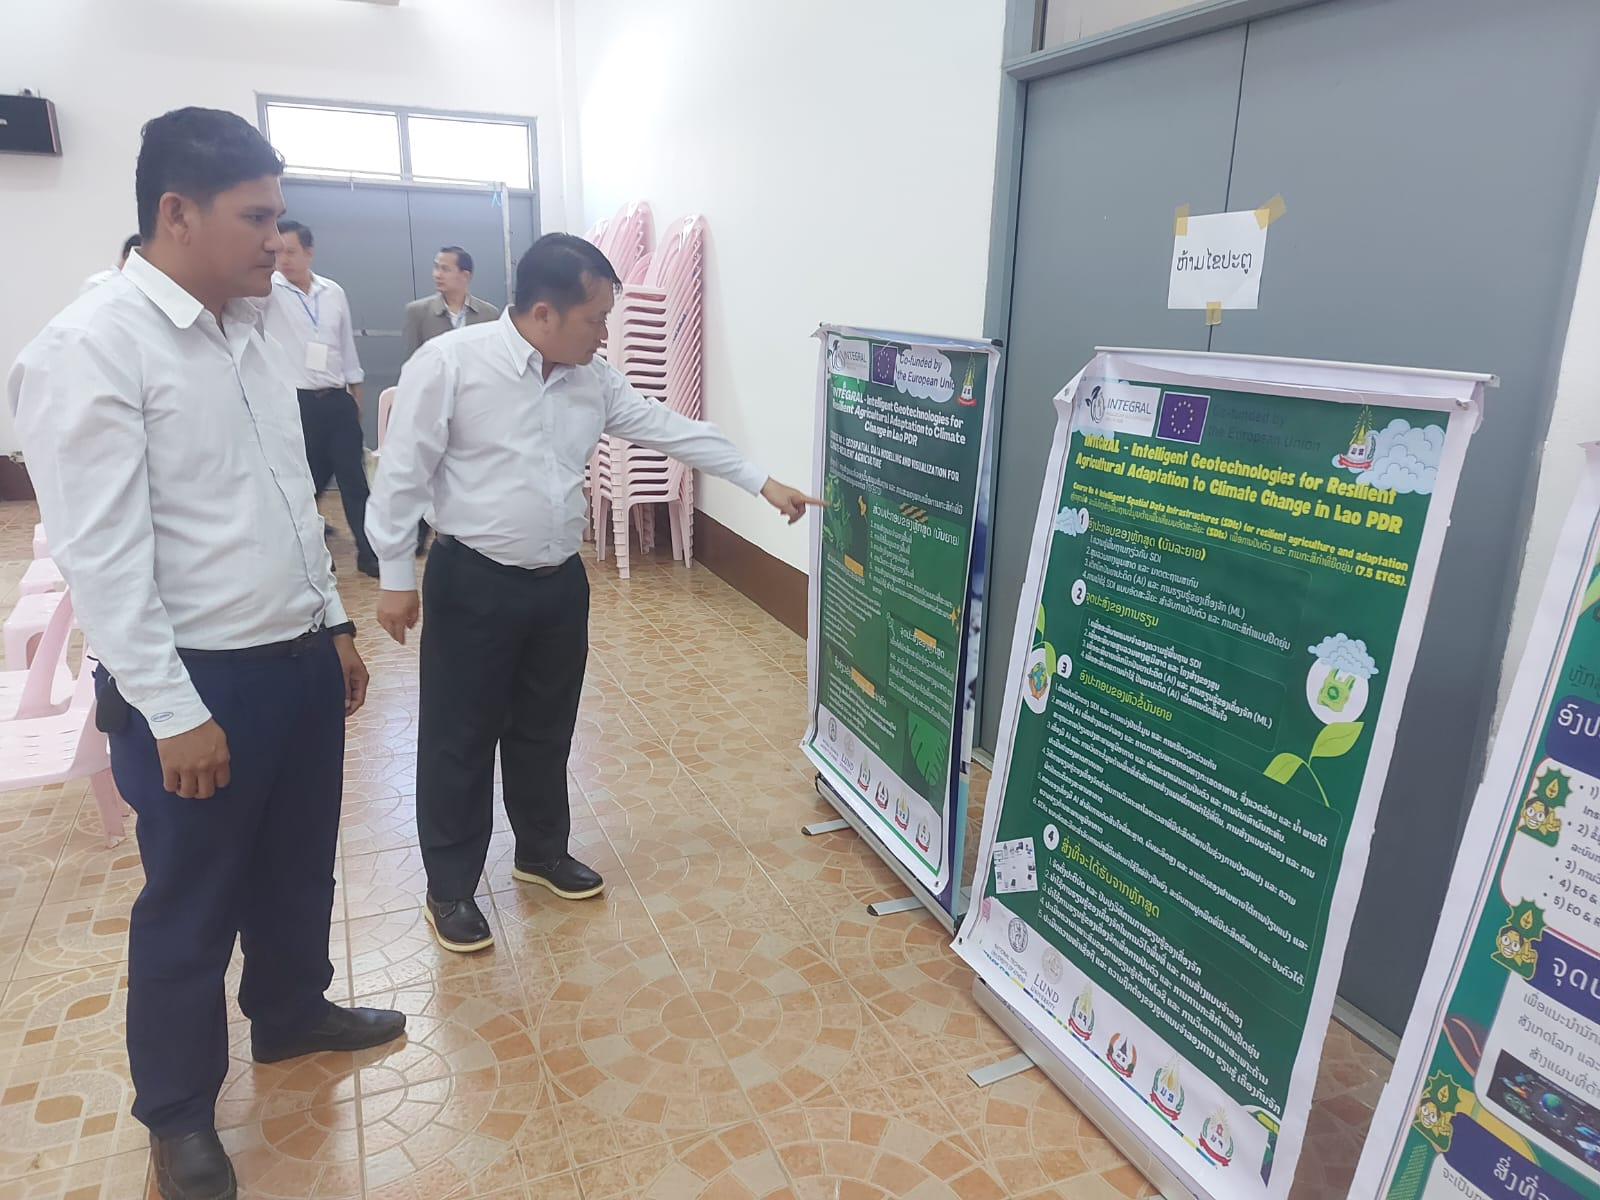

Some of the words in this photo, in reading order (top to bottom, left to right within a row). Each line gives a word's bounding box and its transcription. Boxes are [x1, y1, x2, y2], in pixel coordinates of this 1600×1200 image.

[900, 353, 932, 369] Co-funded
[933, 358, 943, 372] by
[907, 372, 938, 387] European
[1106, 398, 1152, 414] INTEGRAL
[893, 401, 950, 427] Geotechnologies
[950, 416, 964, 429] for
[864, 420, 887, 438] Change
[887, 427, 893, 437] in
[892, 429, 903, 441] Lao
[903, 432, 918, 447] PDR
[925, 423, 933, 437] to
[933, 427, 966, 445] Climate
[947, 468, 960, 482] FOR
[1130, 441, 1189, 469] Intelligent
[1189, 452, 1297, 489] Geotechnologies
[1297, 471, 1324, 491] for
[1325, 476, 1397, 505] Resilient
[1074, 451, 1126, 477] Agricultural
[1126, 462, 1190, 491] Adaptation
[1191, 474, 1207, 492] to
[1208, 477, 1259, 503] Climate
[1258, 488, 1313, 519] Change
[1313, 499, 1331, 519] in
[1333, 504, 1363, 525] Lao
[1364, 510, 1404, 534] PDR
[1126, 495, 1148, 509] Spatial
[1148, 501, 1165, 512] Data
[1243, 522, 1255, 533] for
[1255, 525, 1287, 542] resilient
[1286, 533, 1336, 556] agriculture
[1337, 545, 1354, 558] and
[1354, 549, 1410, 574] adaptation
[1149, 552, 1161, 563] SDI
[1354, 564, 1373, 578] (7.5
[1076, 587, 1082, 599] 2
[1132, 573, 1147, 587] (AI)
[1147, 580, 1159, 590] ແລະ
[1226, 603, 1246, 620] (ML)
[1105, 579, 1115, 589] SDI
[1207, 613, 1220, 624] ແລະ
[1061, 661, 1067, 674] 3
[1188, 657, 1201, 669] SDI
[1163, 672, 1176, 686] (AI)
[1252, 710, 1273, 729] (ML)
[1166, 685, 1180, 701] (AI)
[1558, 703, 1600, 737] ອົງປ
[1278, 814, 1292, 828] ແລະ
[1047, 828, 1054, 842] 4
[1577, 824, 1589, 838] 2)
[1285, 855, 1300, 870] ແລະ
[1300, 864, 1315, 879] ການ
[1565, 860, 1577, 874] 3)
[1264, 880, 1278, 894] ແລະ
[1559, 879, 1571, 892] 4)
[1573, 885, 1588, 898] EO
[1589, 894, 1598, 904] &
[1553, 896, 1565, 910] 5)
[1566, 903, 1581, 917] EO
[1583, 912, 1592, 923] &
[1292, 936, 1308, 952] ແລະ
[1257, 950, 1271, 965] ແລະ
[1166, 961, 1179, 977] ແລະ
[1033, 973, 1060, 1003] LUND
[1158, 973, 1172, 989] ແລະ
[1166, 997, 1180, 1014] ແລະ
